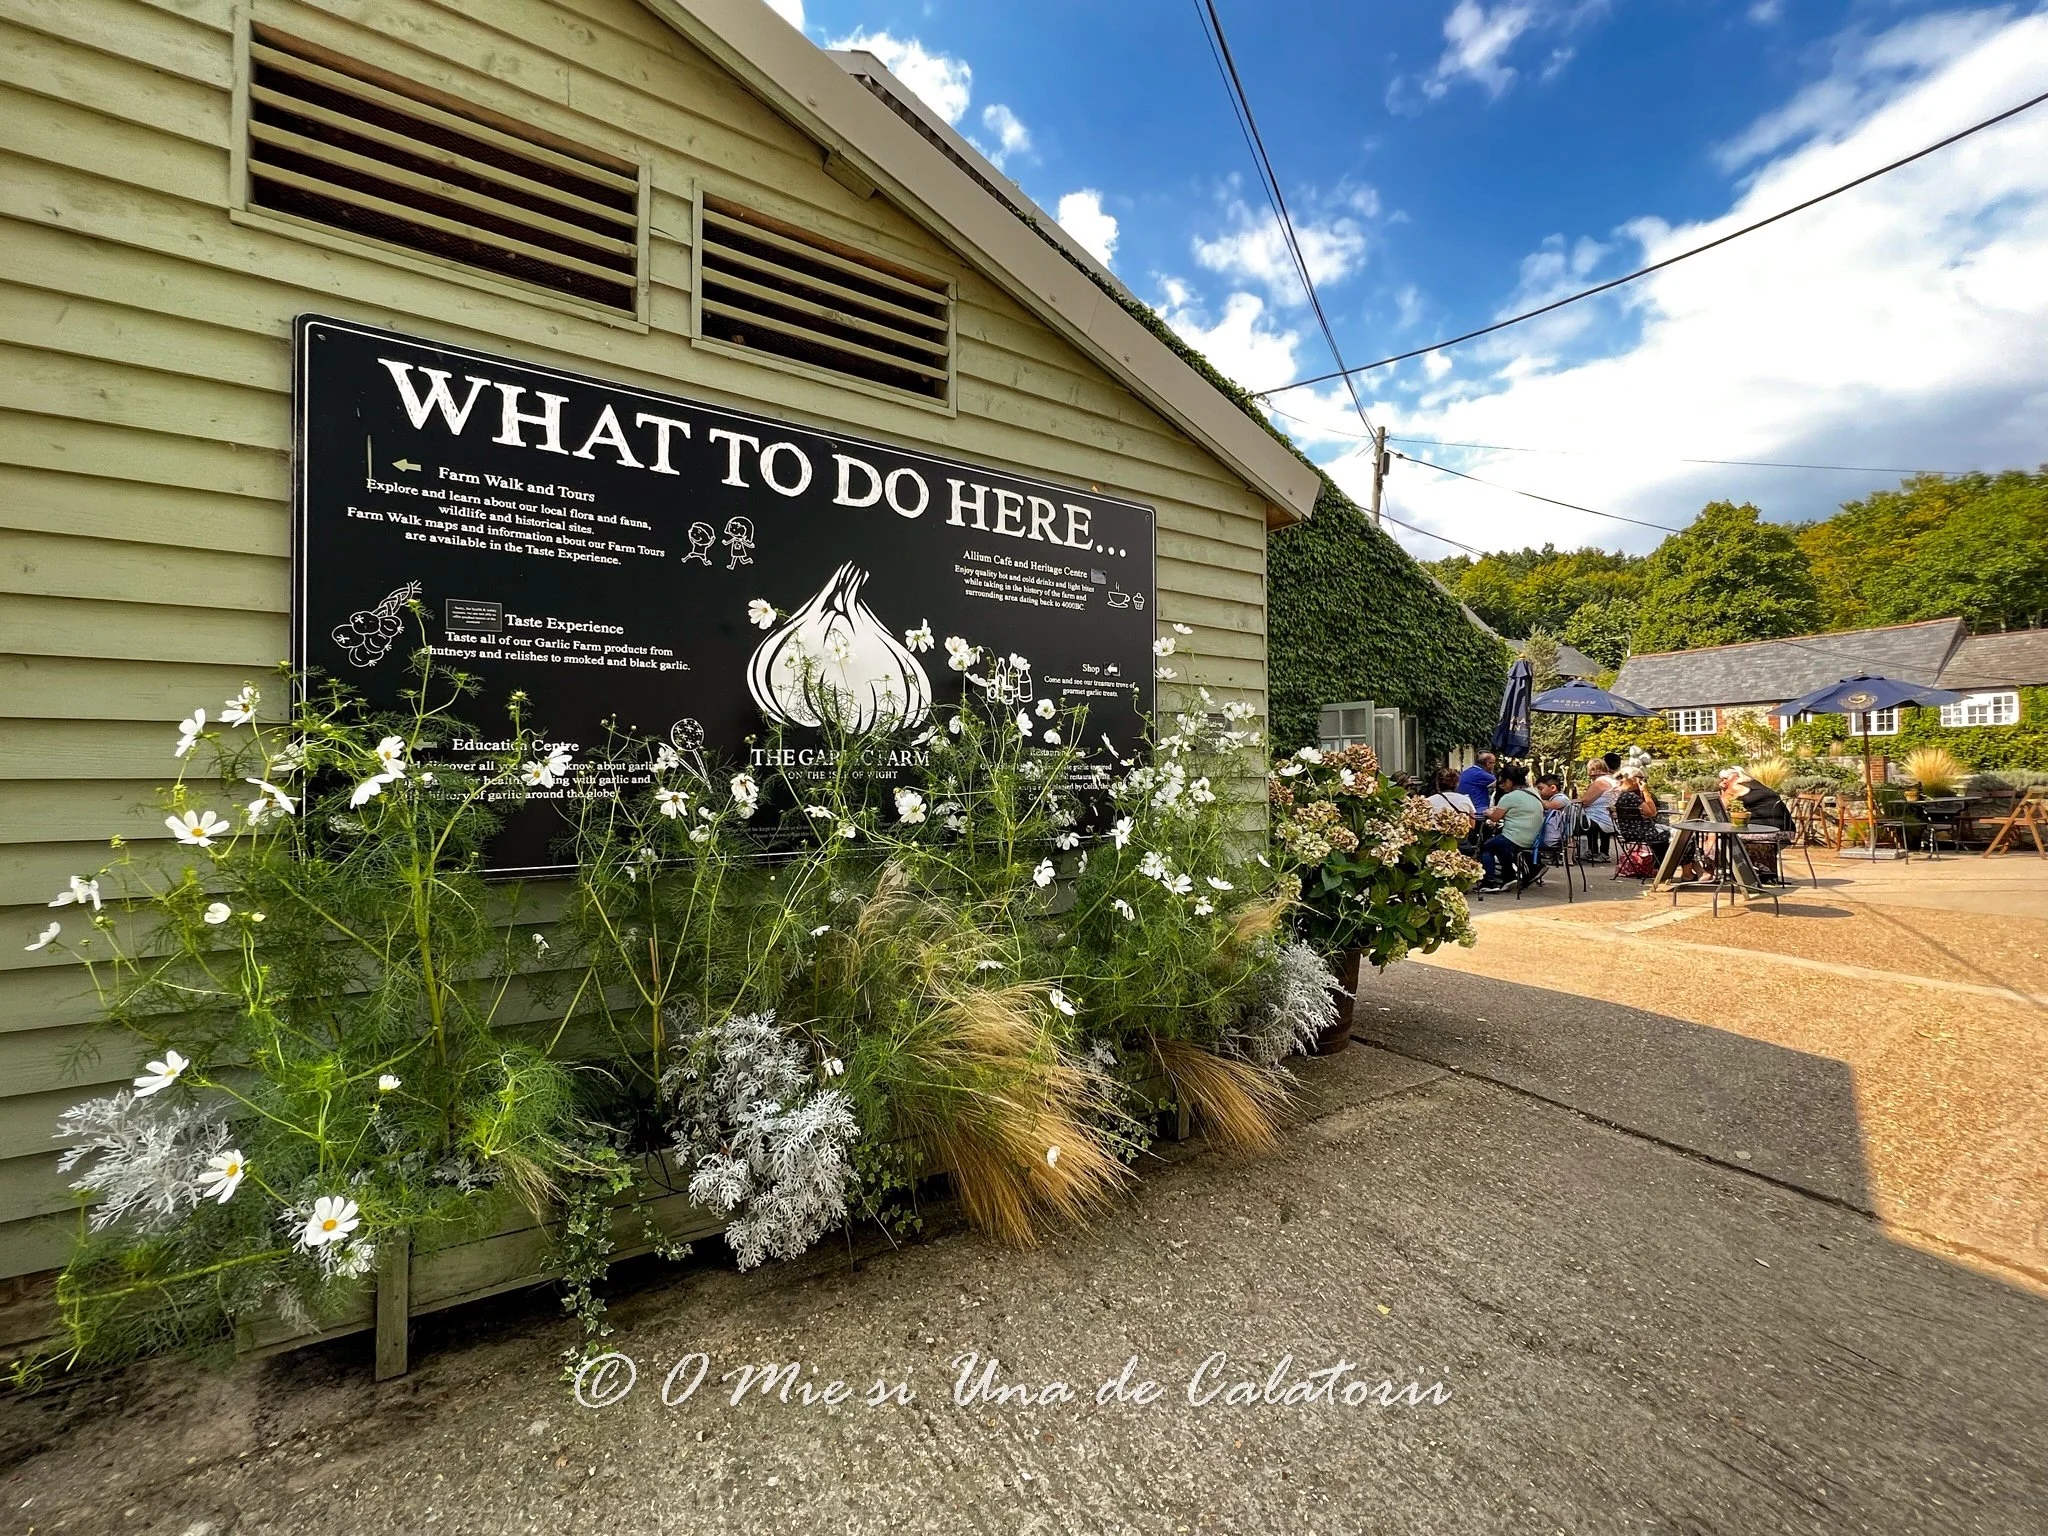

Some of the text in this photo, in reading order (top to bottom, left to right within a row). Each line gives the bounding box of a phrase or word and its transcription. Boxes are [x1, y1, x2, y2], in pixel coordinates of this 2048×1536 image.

[377, 358, 1127, 558] WHAT TO DO HERE...
[438, 466, 595, 502] Farm Walk and Tours
[366, 478, 651, 530] Explore and learn about our local flora and fauna,
[438, 505, 595, 535] wildlife and historical sites.
[347, 506, 665, 557] Farm Walk maps and information about our Farm Tours
[405, 531, 621, 565] are available in the Taste Experience.
[963, 550, 992, 563] Allium
[1014, 559, 1029, 569] and
[1030, 561, 1062, 576] Heritage
[1063, 566, 1088, 579] Centre
[954, 564, 974, 576] Enjoy
[975, 567, 997, 580] quality
[998, 571, 1008, 580] hot
[1009, 573, 1021, 581] and
[1022, 575, 1035, 584] cold
[1036, 577, 1054, 587] drinks
[1055, 580, 1067, 589] and
[1067, 581, 1081, 592] light
[964, 577, 982, 587] while
[983, 579, 1004, 591] taking
[1005, 582, 1012, 590] in
[1012, 583, 1022, 592] the
[1023, 585, 1043, 597] history
[1051, 589, 1061, 598] the
[1061, 591, 1075, 600] farm
[1076, 593, 1087, 602] and
[965, 588, 1004, 601] surrounding
[1004, 594, 1018, 602] area
[1019, 595, 1039, 606] dating
[1039, 598, 1054, 607] back
[1054, 600, 1061, 608] to
[505, 613, 543, 628] Taste
[546, 617, 624, 635] Experience
[445, 631, 673, 657] Taste all of our Garlic Farm products from
[479, 649, 502, 660] and
[504, 650, 549, 662] relishes
[551, 654, 561, 662] to
[563, 654, 605, 665] smoked
[606, 657, 627, 667] and
[629, 657, 658, 669] black
[659, 660, 691, 671] garlic.
[1082, 663, 1100, 675] Shop
[1043, 675, 1061, 684] Come
[1061, 677, 1073, 685] and
[1086, 688, 1102, 697] garlic
[531, 740, 580, 752] Centre
[478, 760, 495, 771] all
[566, 761, 596, 771] know
[596, 761, 626, 771] about
[628, 761, 653, 773] garli
[750, 748, 796, 767] THE
[798, 748, 875, 767] GARC
[571, 775, 596, 784] with
[598, 775, 629, 786] garlic
[631, 775, 651, 784] and
[807, 770, 826, 780] THE
[852, 770, 864, 780] OF
[473, 789, 487, 800] of
[487, 789, 522, 802] garlic
[525, 789, 564, 799] around
[587, 789, 615, 800] globe
